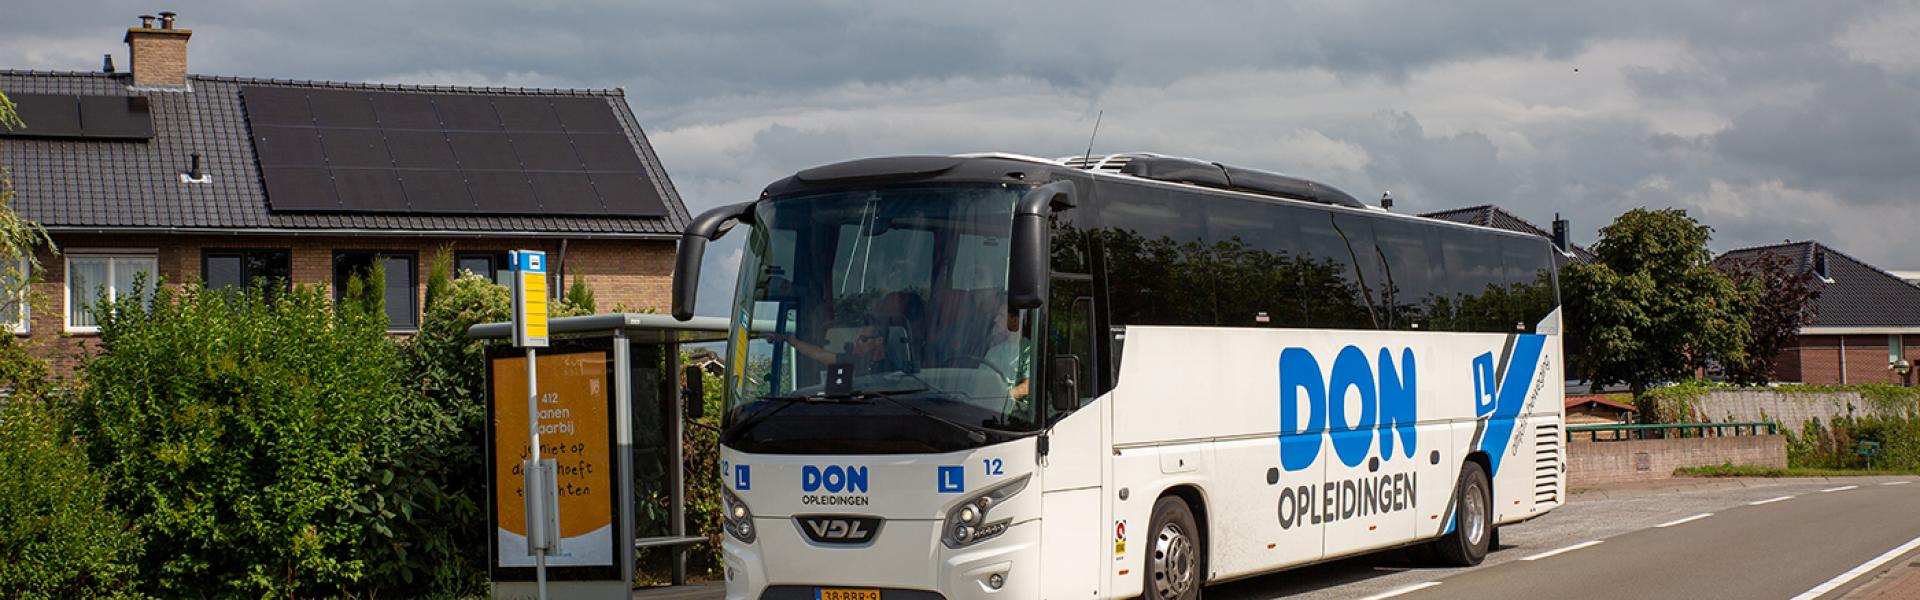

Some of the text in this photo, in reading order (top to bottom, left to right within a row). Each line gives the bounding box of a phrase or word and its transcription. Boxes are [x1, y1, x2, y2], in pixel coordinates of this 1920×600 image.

[541, 393, 559, 404] 412
[1279, 344, 1417, 472] DON
[538, 421, 575, 435] aarbij
[540, 443, 566, 454] niet
[571, 443, 585, 456] op
[557, 460, 593, 480] hoeft
[983, 458, 1004, 475] 12
[802, 465, 868, 493] DON
[802, 494, 869, 506] OPLEIDINGEN
[1277, 471, 1417, 530] OPLEIDINGEN
[807, 519, 869, 539] VDL
